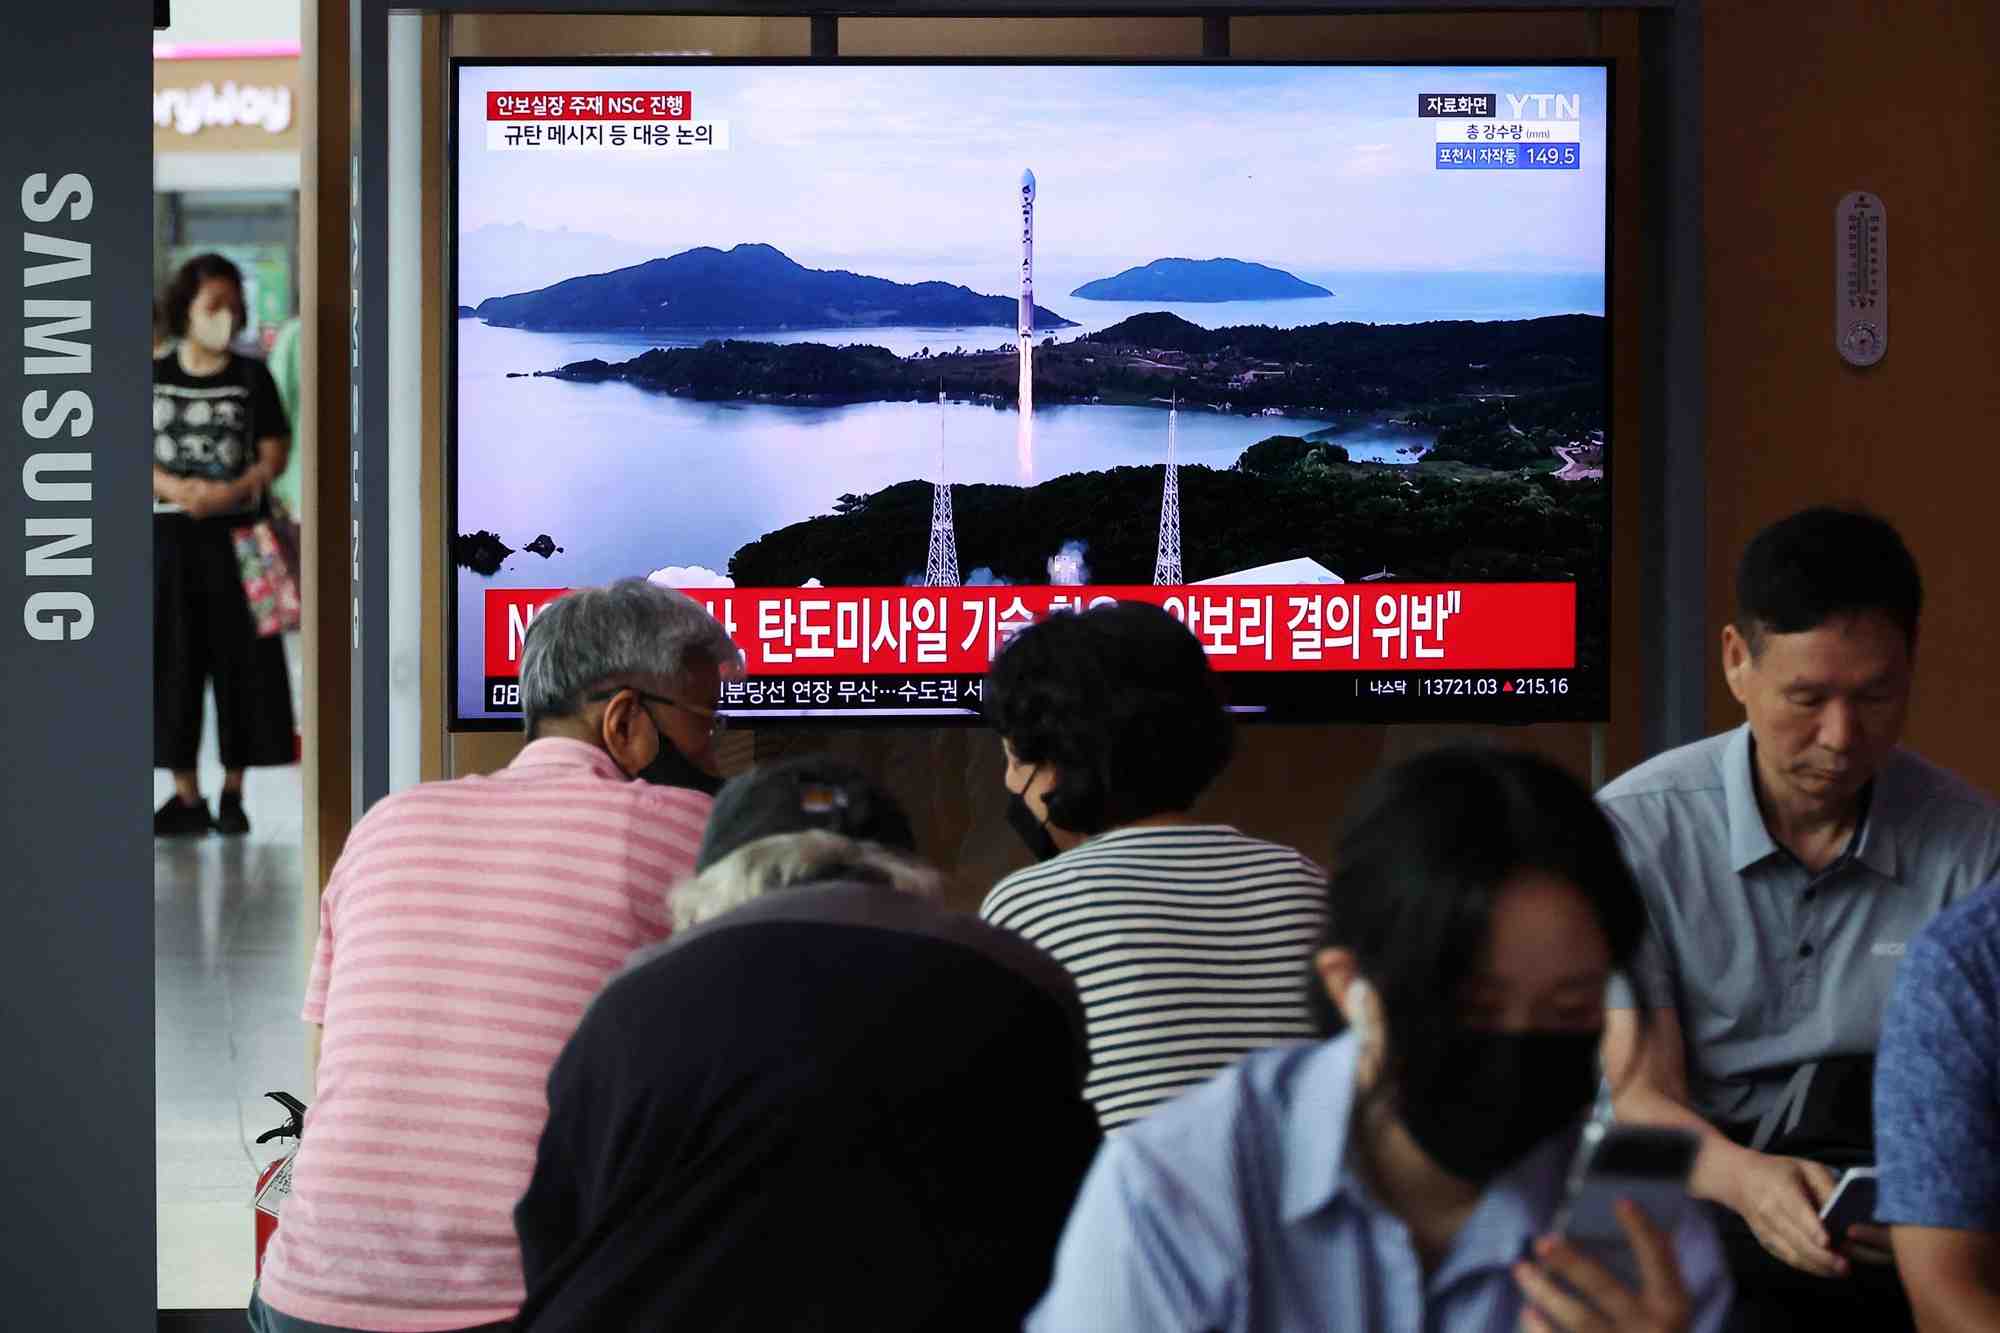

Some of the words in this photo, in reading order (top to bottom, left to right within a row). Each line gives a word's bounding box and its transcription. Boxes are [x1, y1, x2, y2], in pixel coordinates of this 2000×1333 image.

[496, 96, 565, 116] 안보실장
[569, 96, 603, 116] 주재
[608, 97, 645, 114] NSC
[650, 96, 683, 116] 진행
[1427, 96, 1487, 114] 자료화면
[1506, 94, 1580, 119] YTN
[504, 125, 542, 145] 규탄
[548, 125, 603, 145] 메시지
[609, 125, 628, 145] 등
[634, 125, 671, 145] 대응
[676, 125, 713, 145] 논의
[1466, 124, 1479, 140] 총
[1483, 124, 1523, 140] 강수량
[1526, 129, 1551, 139] (mm)
[1439, 149, 1476, 164] 포천시
[1479, 149, 1517, 165] 자작동
[1526, 148, 1575, 164] 149.5
[20, 172, 95, 642] SAMSUNG
[758, 597, 948, 664] 탄도미사일
[1287, 594, 1360, 660] 결의
[1372, 590, 1461, 660] 위반"
[792, 680, 833, 704] 연장
[1369, 680, 1408, 695] 나스닥
[1423, 678, 1498, 696] 13721.03
[1515, 678, 1569, 695] 215.16
